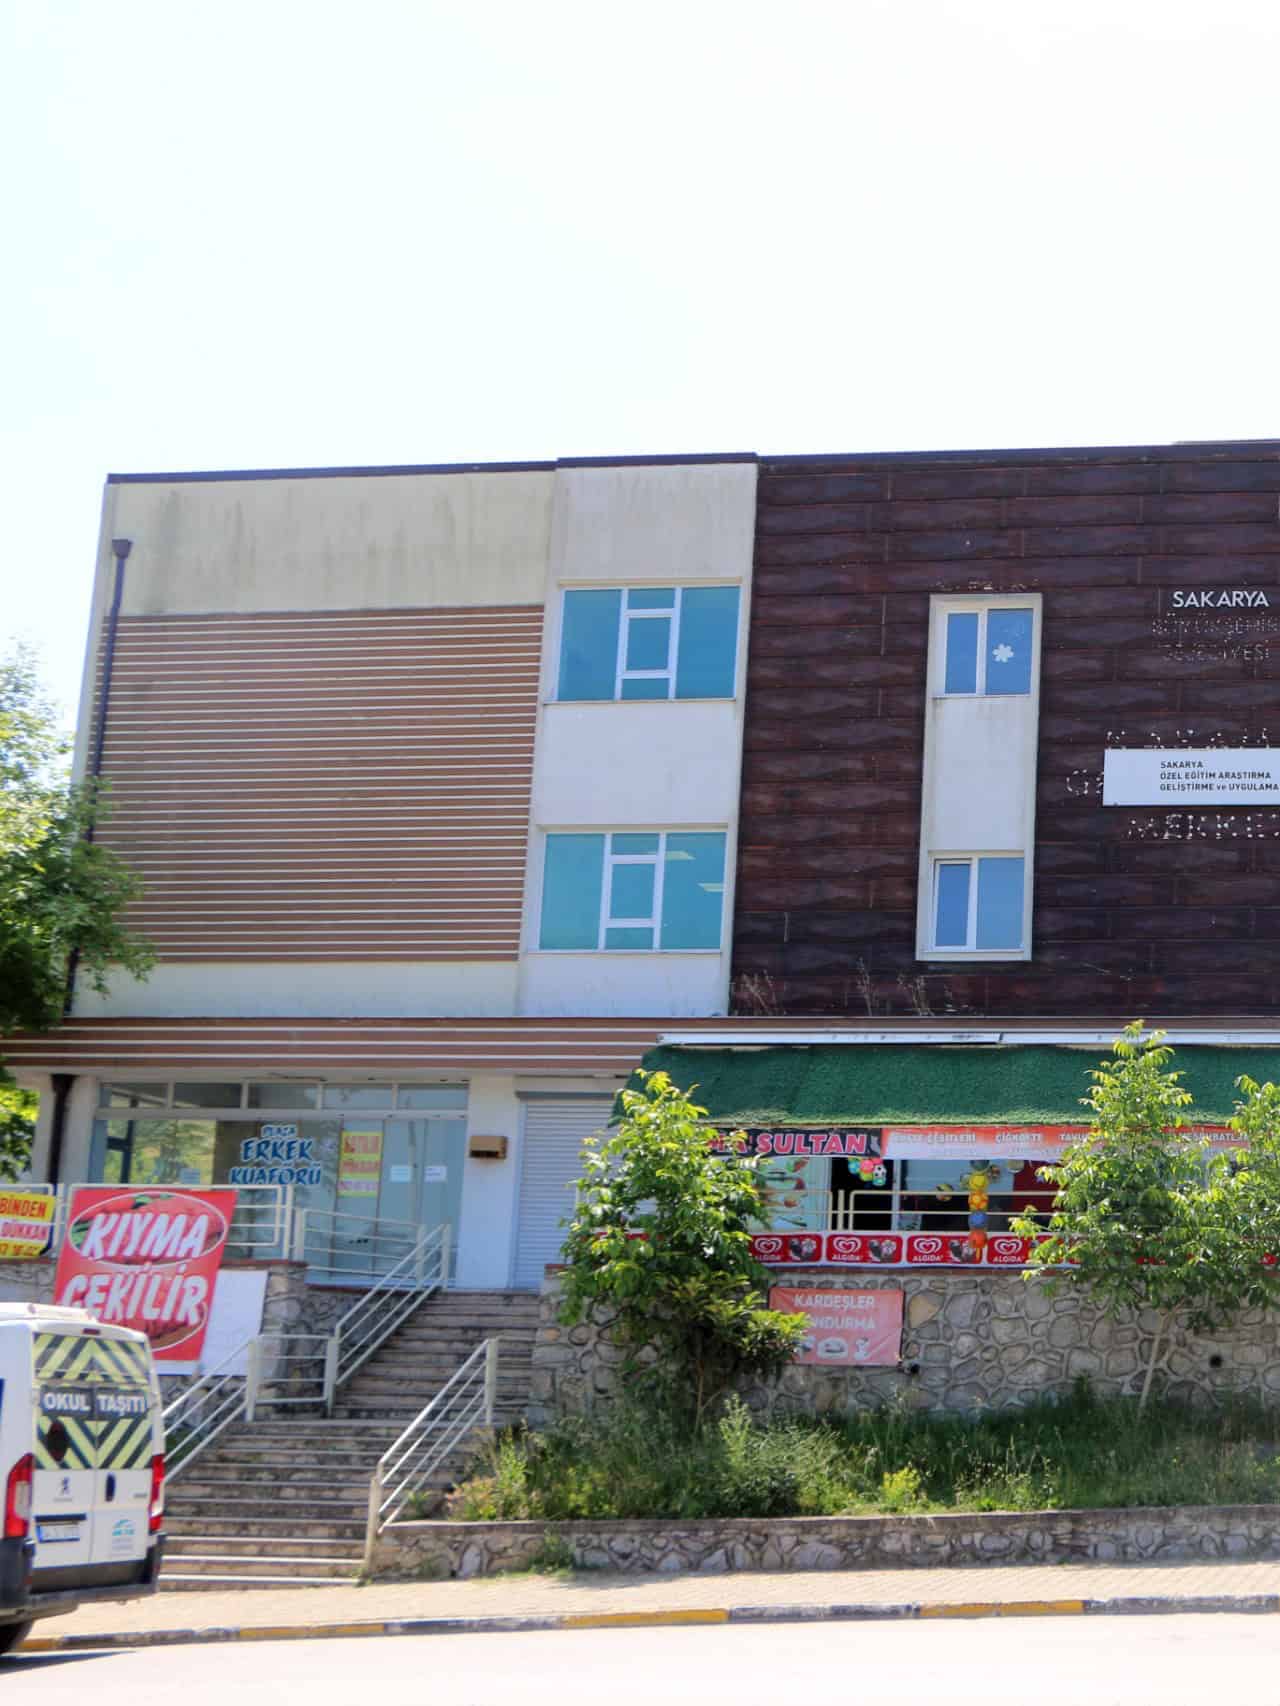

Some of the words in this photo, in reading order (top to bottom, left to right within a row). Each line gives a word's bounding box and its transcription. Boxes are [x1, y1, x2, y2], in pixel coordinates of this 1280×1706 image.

[1173, 590, 1270, 608] SAKARYA
[1160, 760, 1204, 769] SAKARYA
[1160, 771, 1182, 780] ÖZEL
[1185, 771, 1216, 780] EĞİTİM
[1218, 771, 1272, 780] ARAŞTIRMA
[1160, 782, 1213, 792] GELİŞTİRME
[1229, 783, 1279, 791] UYGULAMA
[242, 1139, 313, 1162] ERKEK
[757, 1132, 868, 1154] SULTAN
[230, 1161, 321, 1185] KUAFÖRÜ
[81, 1212, 208, 1259] KIYMA
[794, 1294, 875, 1311] KARDEŞLER
[813, 1316, 876, 1330] NDURMA
[43, 1393, 92, 1411] OKUL
